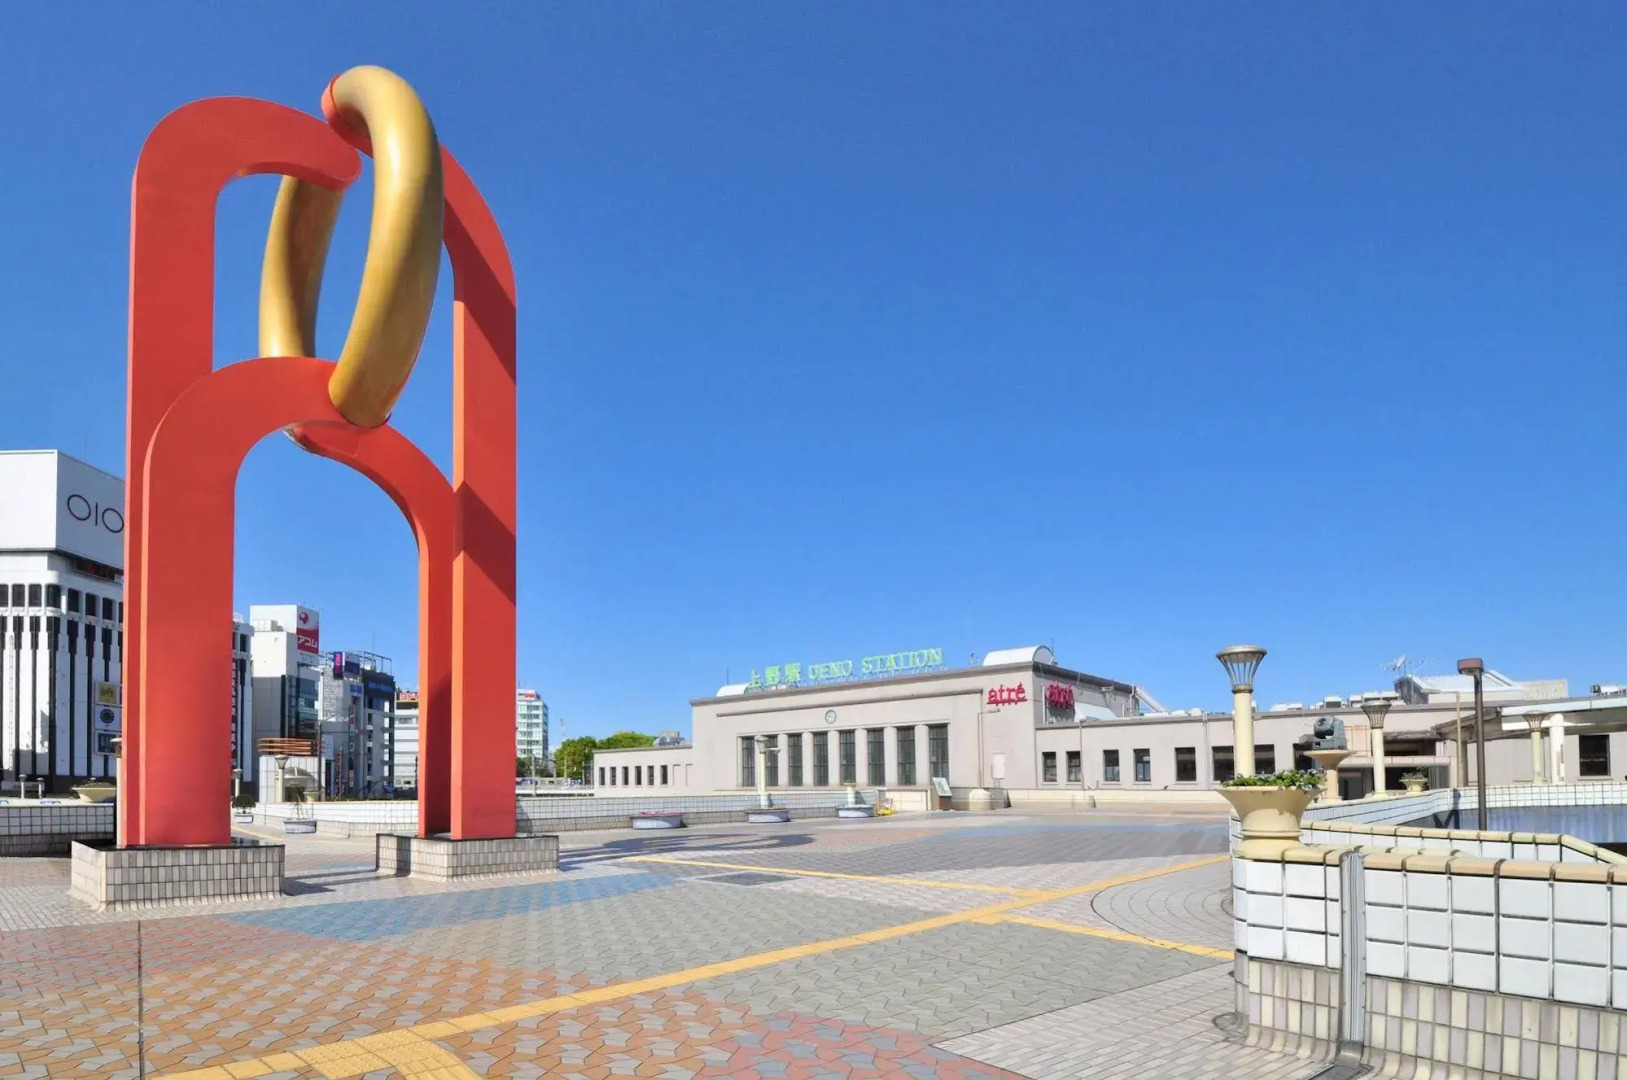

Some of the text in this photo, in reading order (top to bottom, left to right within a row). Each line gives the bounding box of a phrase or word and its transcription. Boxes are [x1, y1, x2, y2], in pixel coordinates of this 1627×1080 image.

[298, 635, 318, 649] アコム
[808, 647, 942, 680] UENO STATION
